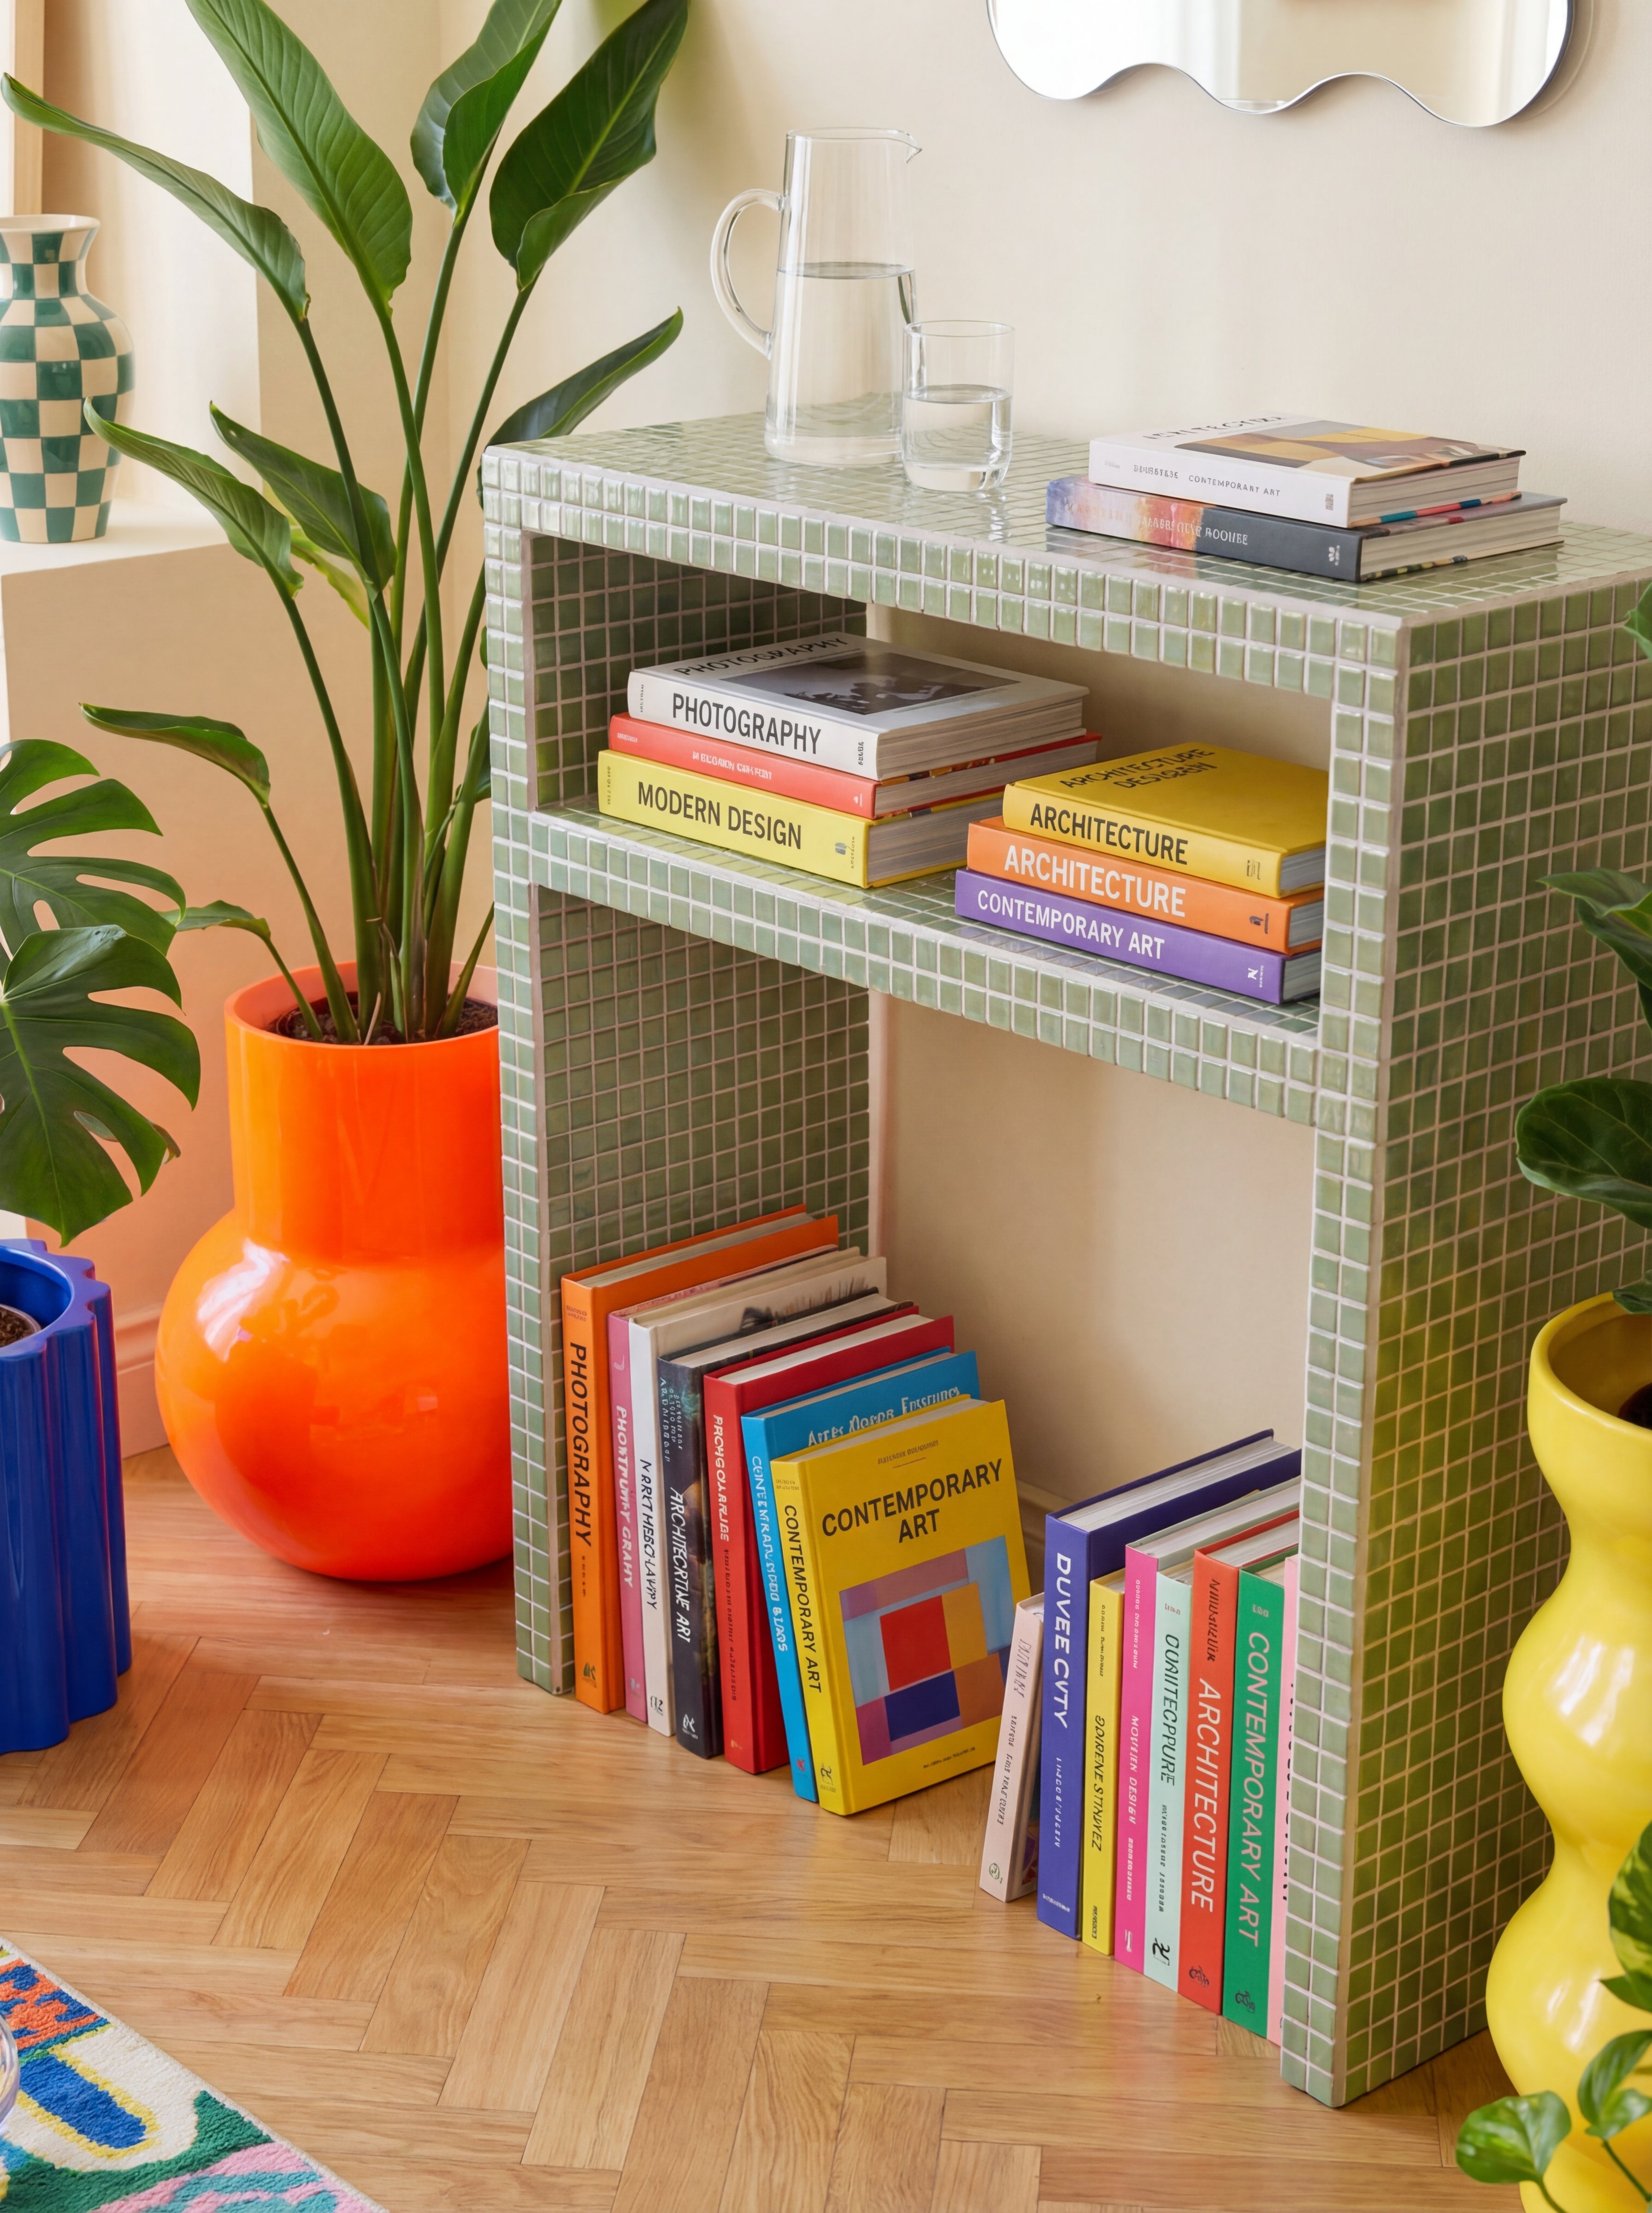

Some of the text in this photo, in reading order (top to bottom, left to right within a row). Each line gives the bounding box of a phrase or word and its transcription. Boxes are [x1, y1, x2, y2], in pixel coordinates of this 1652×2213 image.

[1263, 488, 1280, 497] ART
[673, 693, 821, 754] PHOTOGRAPHY
[638, 781, 720, 826] MODERN
[728, 805, 801, 850] DESIGN
[1030, 803, 1189, 866] ARCHITECTURE
[1004, 845, 1186, 918] ARCHITECTURE
[978, 890, 1165, 960] CONTEMPORARY ART
[570, 1342, 592, 1547] PHOTOGRAPHY
[822, 1458, 1003, 1537] CONTEMPORARY
[898, 1509, 939, 1543] ART
[785, 1505, 816, 1653] CONTEMPORARY
[805, 1656, 822, 1693] ART
[1240, 1632, 1270, 1881] CONTEMPORARY
[1191, 1678, 1221, 1913] ARCHITECTURE
[1238, 1882, 1260, 1948] ART
